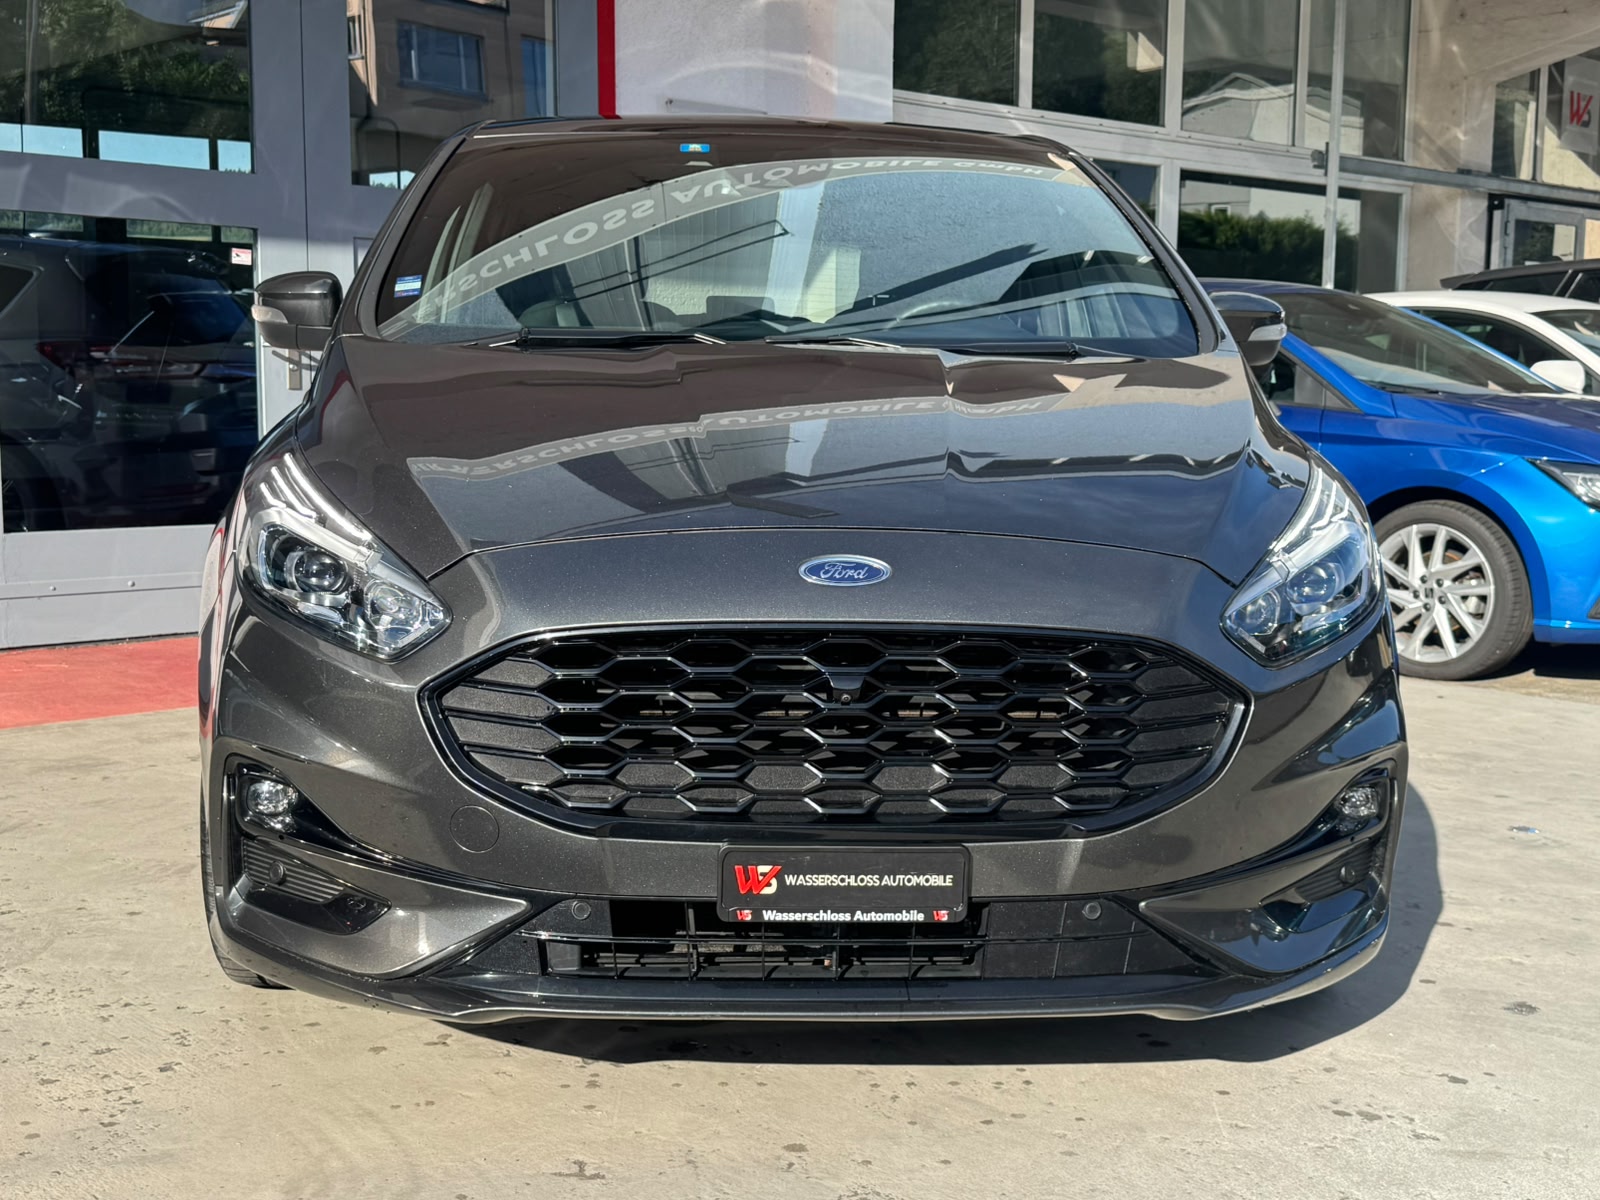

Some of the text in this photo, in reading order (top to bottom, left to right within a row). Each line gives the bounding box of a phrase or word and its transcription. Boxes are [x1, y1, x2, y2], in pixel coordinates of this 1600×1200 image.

[820, 562, 868, 579] Ford
[785, 874, 954, 887] WASSERSCHLOSS AUTOMOBILE
[762, 909, 851, 922] Wasserschloss
[853, 909, 925, 922] Automobile
